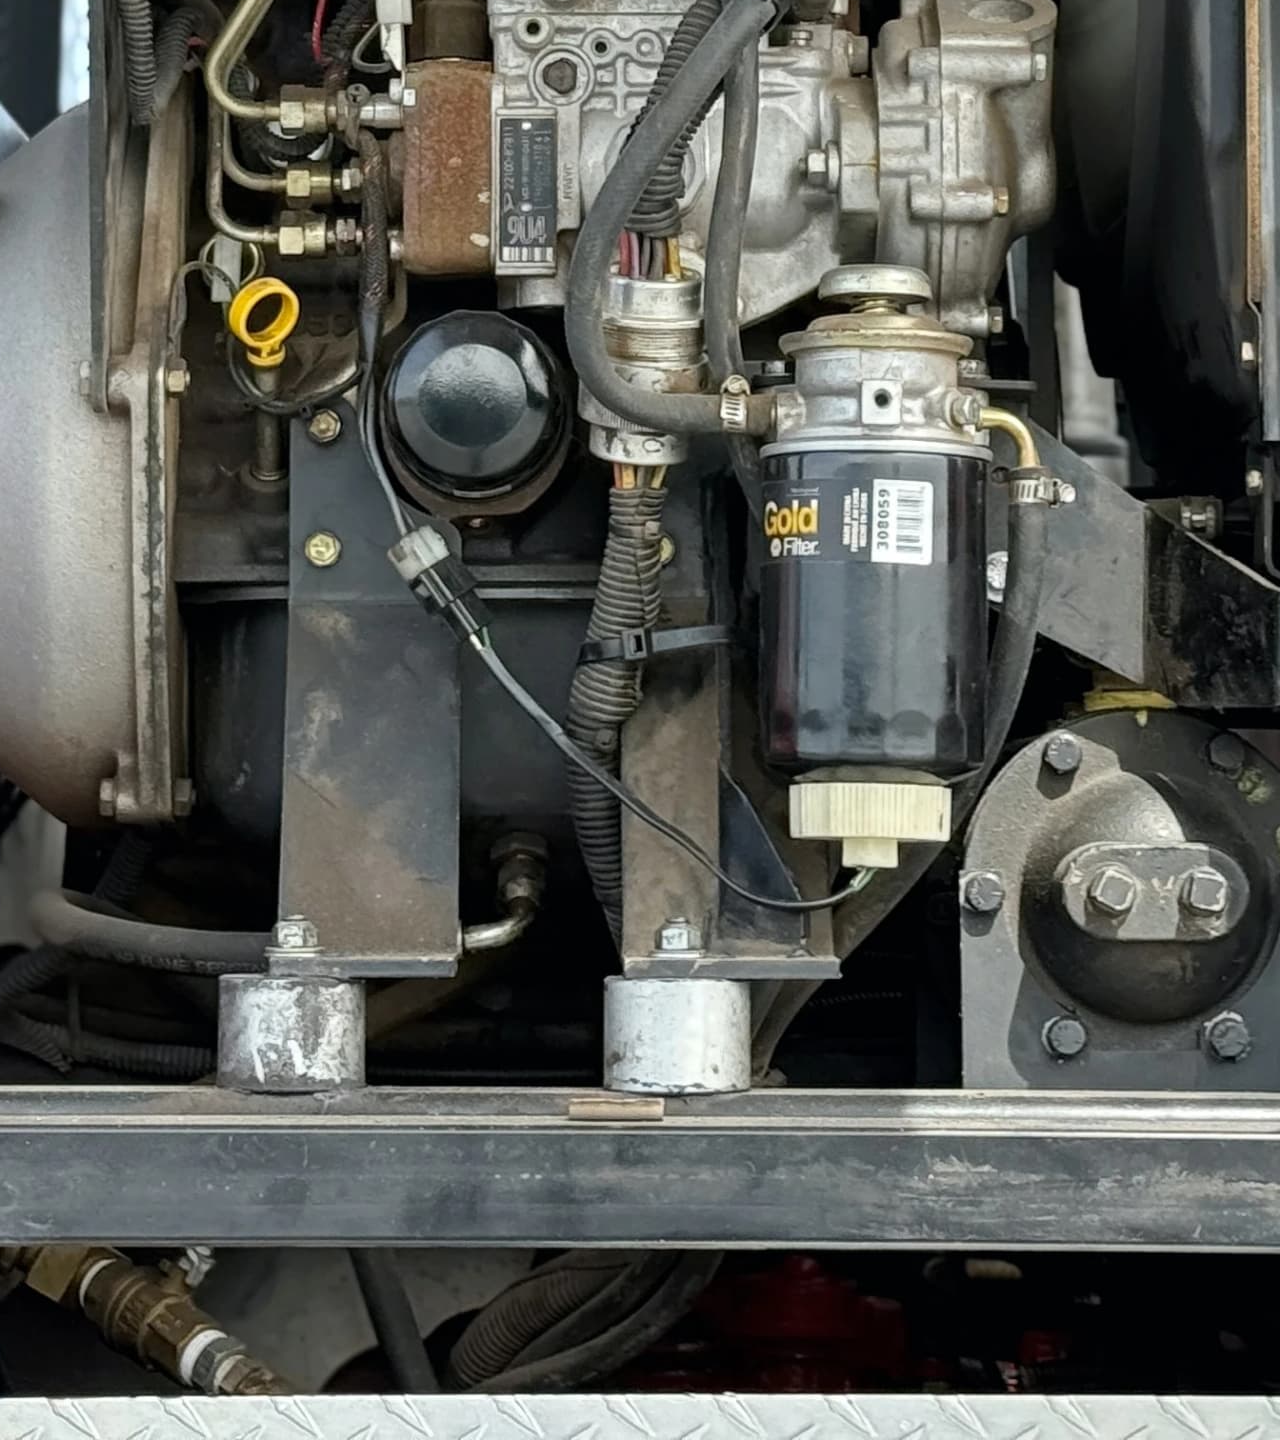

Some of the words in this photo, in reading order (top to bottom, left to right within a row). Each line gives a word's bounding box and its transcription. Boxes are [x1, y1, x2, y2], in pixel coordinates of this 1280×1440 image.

[764, 499, 818, 536] Gold
[876, 489, 890, 550] 308059
[782, 537, 821, 556] Filter
